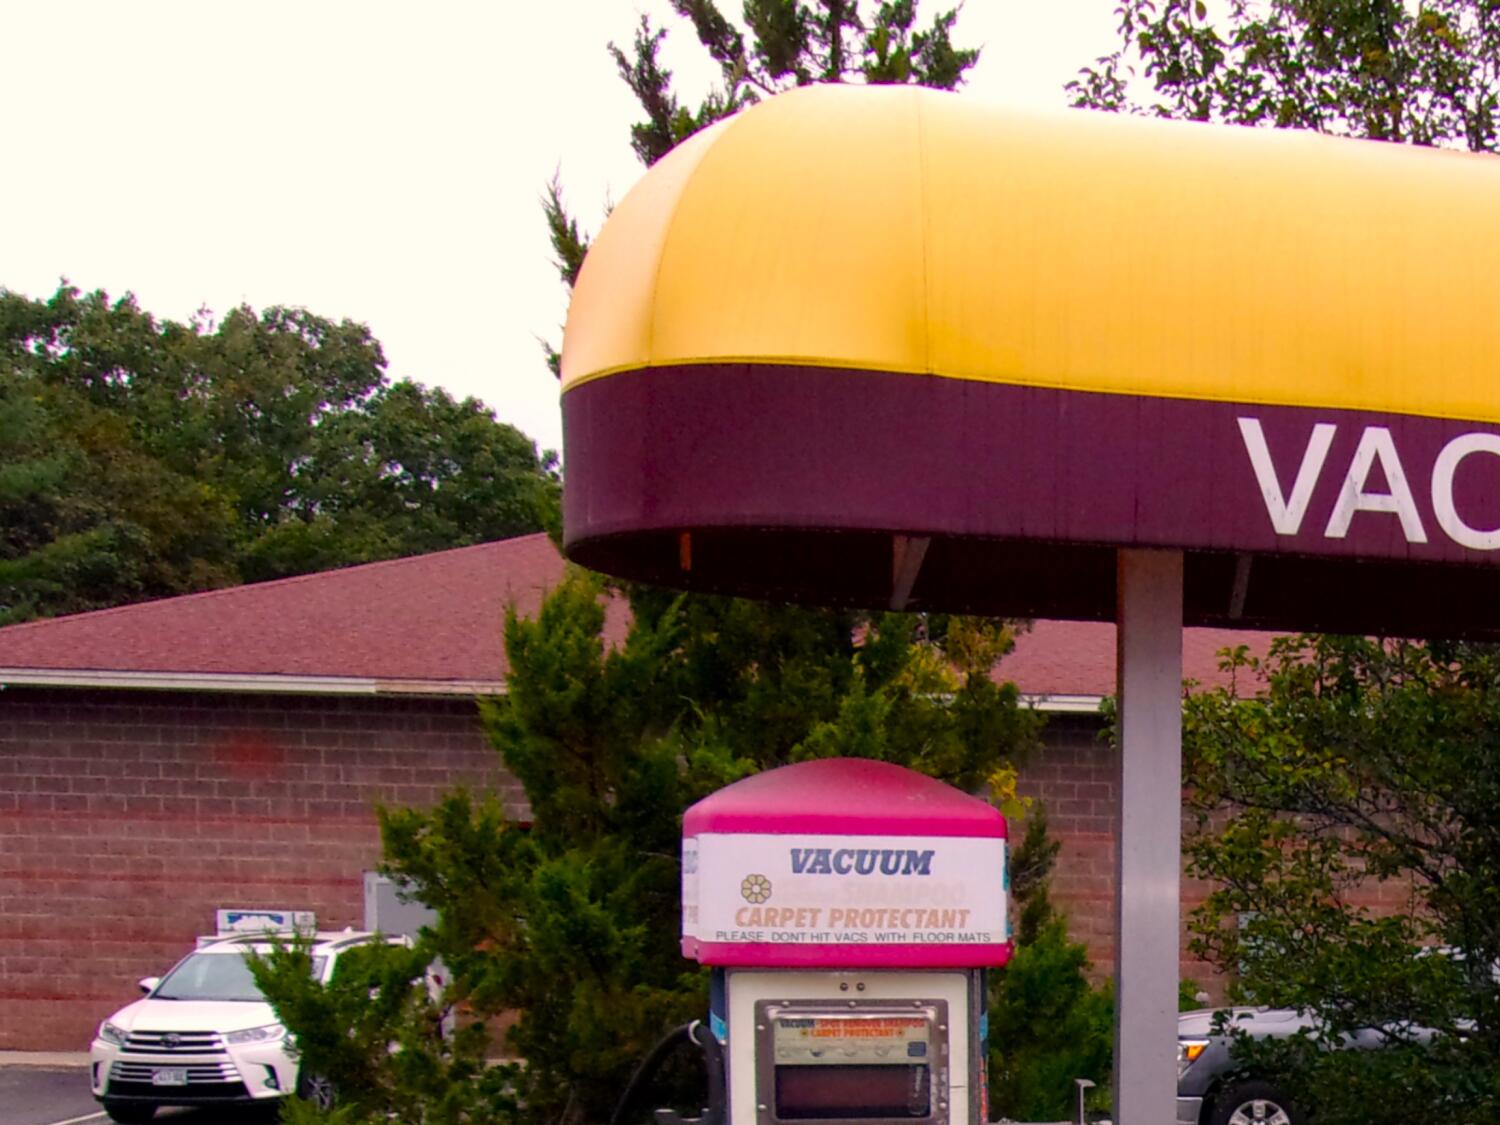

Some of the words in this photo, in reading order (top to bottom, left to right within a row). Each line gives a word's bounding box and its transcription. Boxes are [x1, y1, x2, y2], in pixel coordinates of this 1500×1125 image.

[790, 848, 935, 875] VACUUM
[735, 907, 823, 929] CARPET
[829, 908, 971, 929] PROTECTANT
[716, 931, 764, 942] PLEASE
[810, 932, 830, 942] HIT
[835, 932, 868, 942] VACS
[875, 932, 906, 942] WITH
[913, 932, 955, 943] FLOOR
[958, 932, 991, 943] MATS
